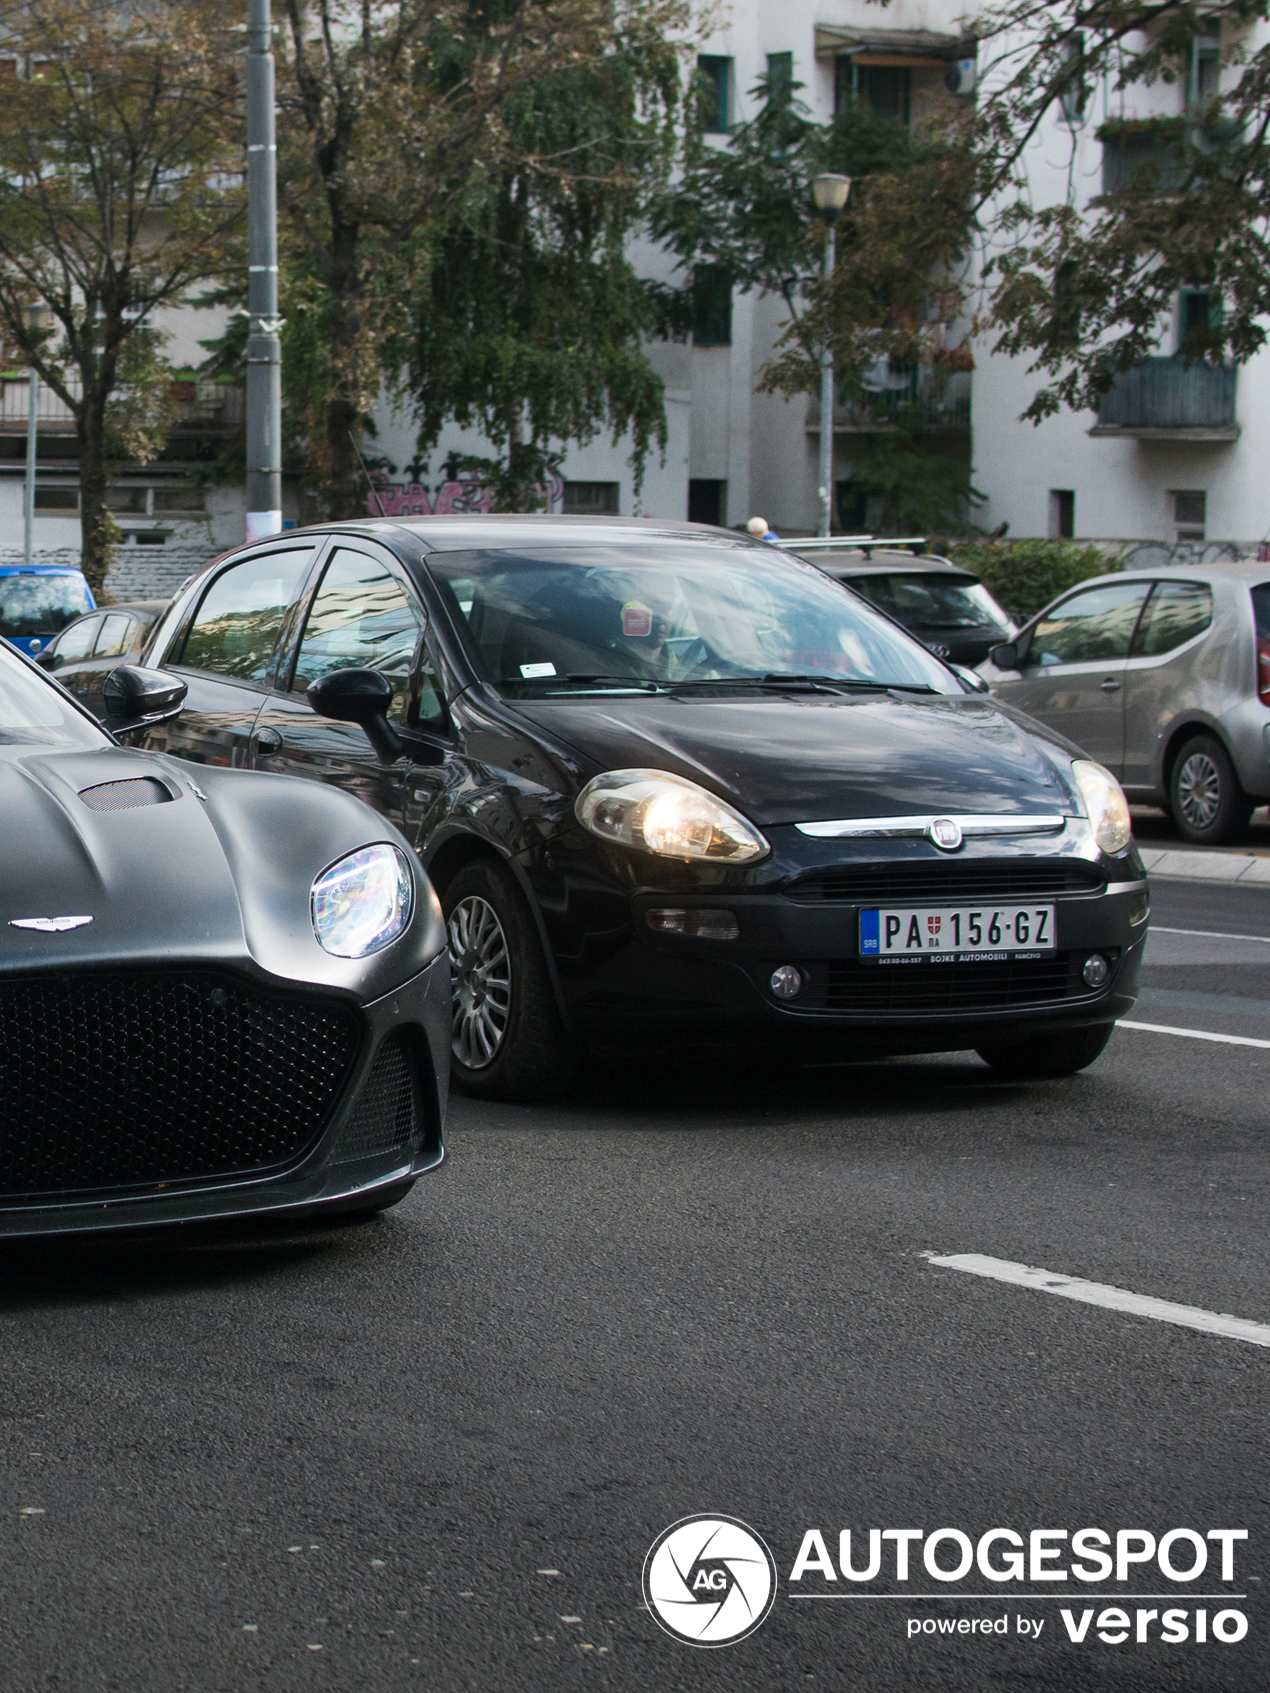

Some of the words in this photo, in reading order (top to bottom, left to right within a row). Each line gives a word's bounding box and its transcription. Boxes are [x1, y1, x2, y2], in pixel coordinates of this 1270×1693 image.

[935, 826, 956, 841] FIAT
[885, 914, 923, 948] PA
[863, 939, 878, 949] SRB
[930, 954, 955, 963] BOJKE
[959, 953, 1008, 962] AUTOMOBILI
